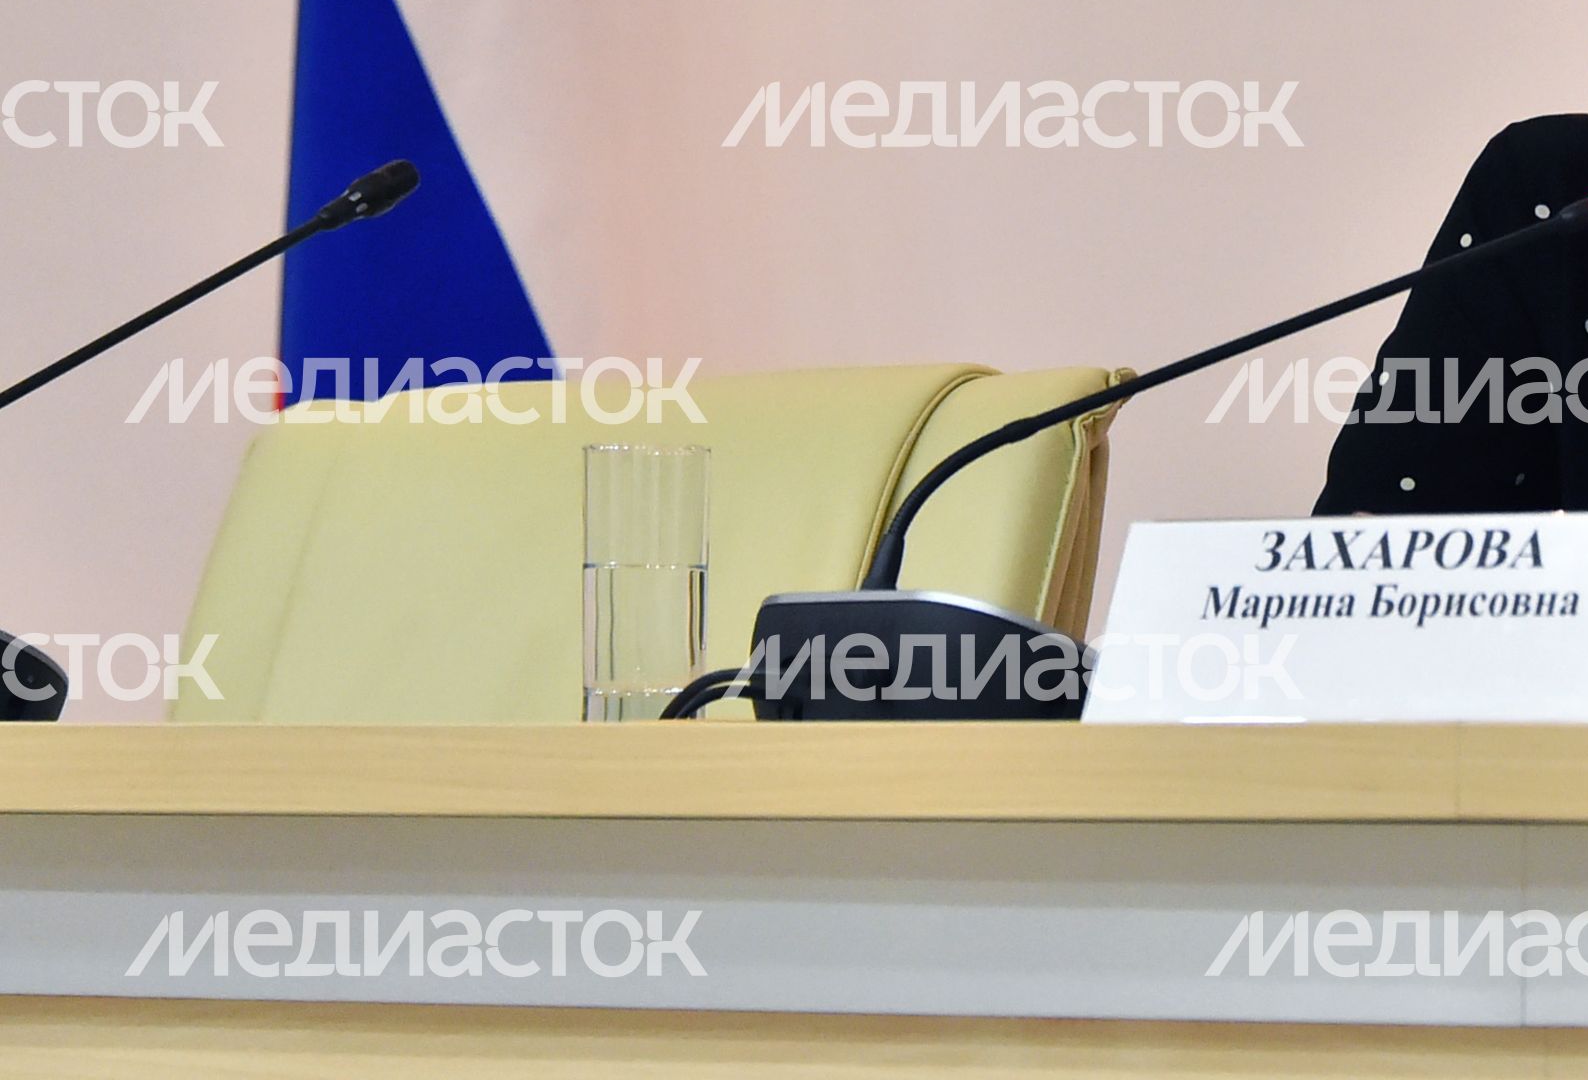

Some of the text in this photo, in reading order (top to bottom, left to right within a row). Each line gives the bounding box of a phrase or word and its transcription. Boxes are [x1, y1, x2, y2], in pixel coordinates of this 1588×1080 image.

[1254, 528, 1545, 573] ЗАХАРОВА
[1200, 583, 1580, 628] Марина Борисовна
